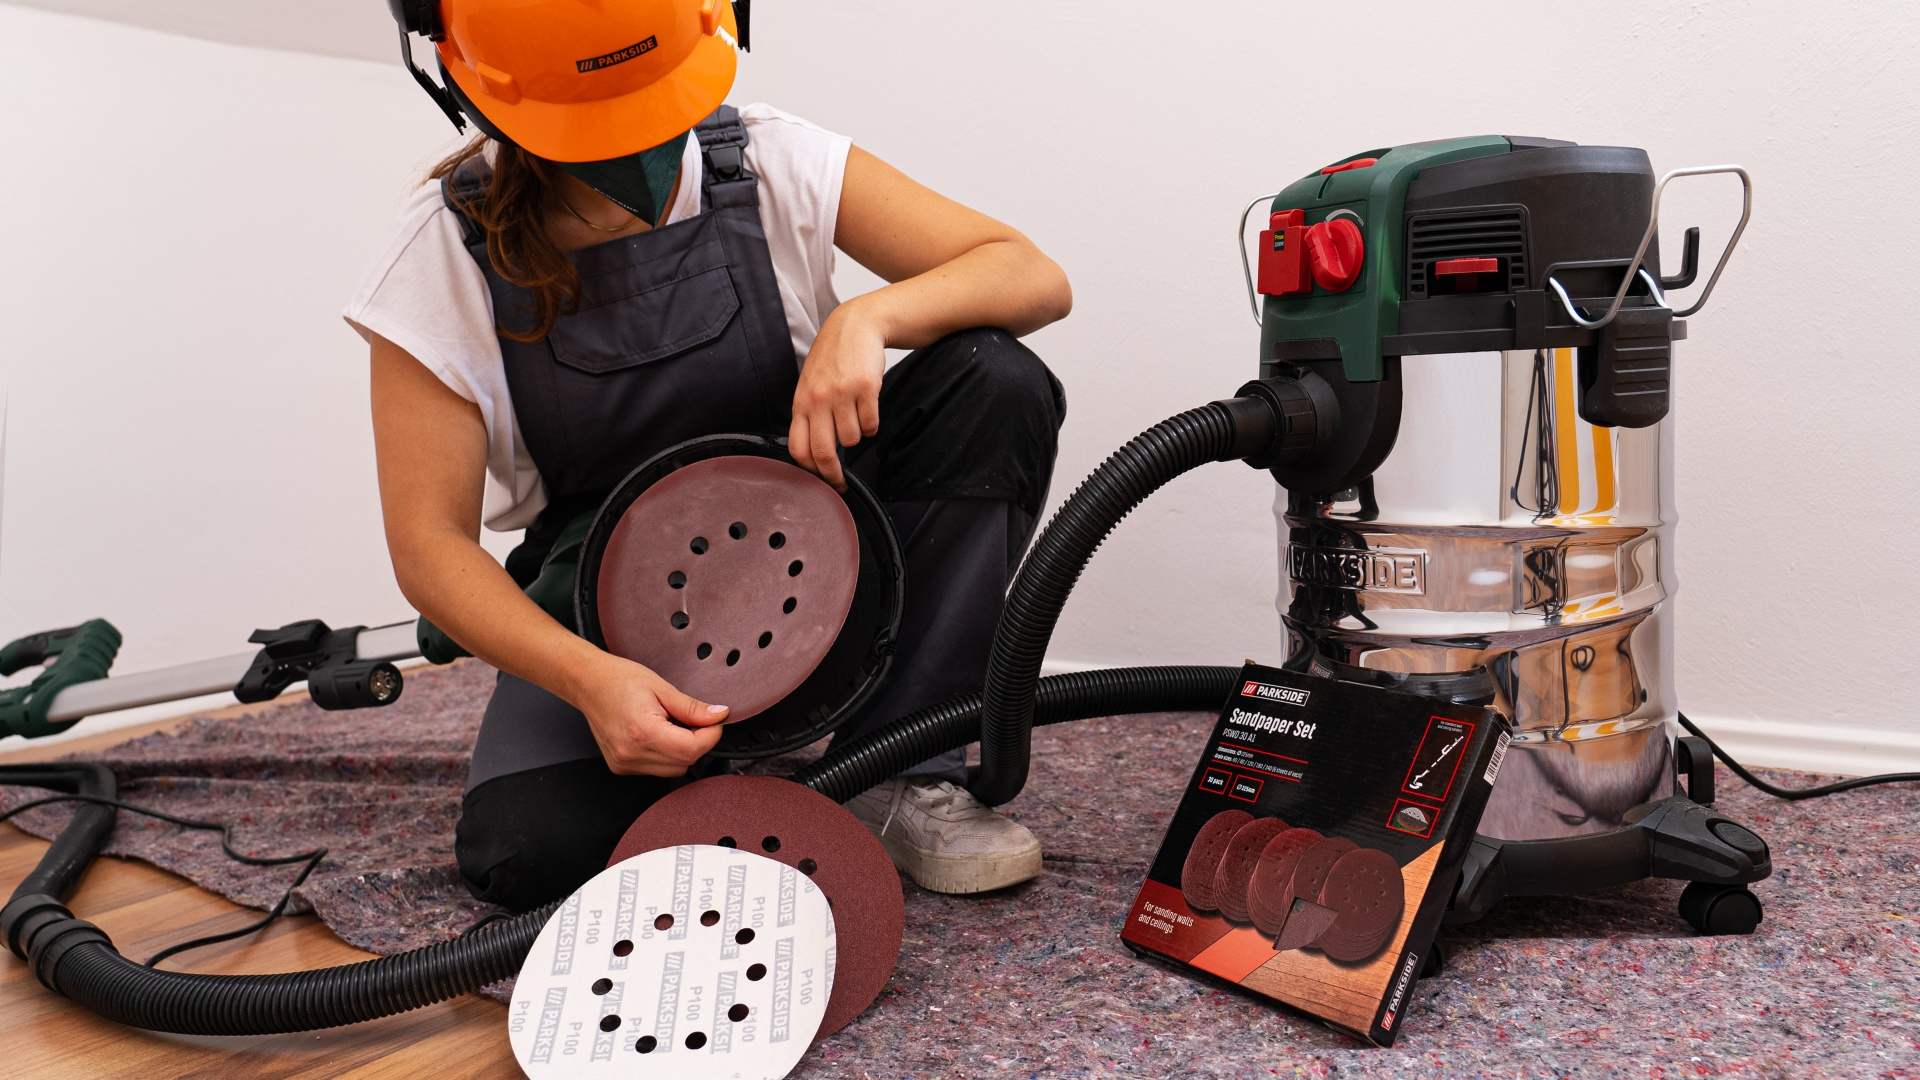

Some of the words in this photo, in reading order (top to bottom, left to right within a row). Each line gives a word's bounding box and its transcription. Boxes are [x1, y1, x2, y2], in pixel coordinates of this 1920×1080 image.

[598, 38, 655, 67] PARKSIDE
[1256, 685, 1305, 703] PARKSIDE
[1229, 707, 1294, 734] Sandpaper
[1292, 719, 1317, 740] Set
[671, 865, 691, 939] PARKSIDE
[699, 878, 714, 910] P100
[585, 909, 602, 945] P100
[642, 906, 658, 940] P100
[752, 896, 766, 929] P100
[1138, 913, 1152, 924] and
[1149, 918, 1174, 934] ceilings
[1143, 901, 1155, 912] For
[1153, 906, 1178, 923] sanding
[1176, 914, 1194, 927] walls
[773, 961, 791, 1039] PARKSIDE
[800, 968, 814, 1006] P100
[1389, 957, 1415, 1012] PARKSIDE
[510, 1001, 531, 1033] P100
[657, 974, 678, 1049] PARKSIDE
[686, 986, 703, 1021] P100
[562, 1022, 583, 1056] P100
